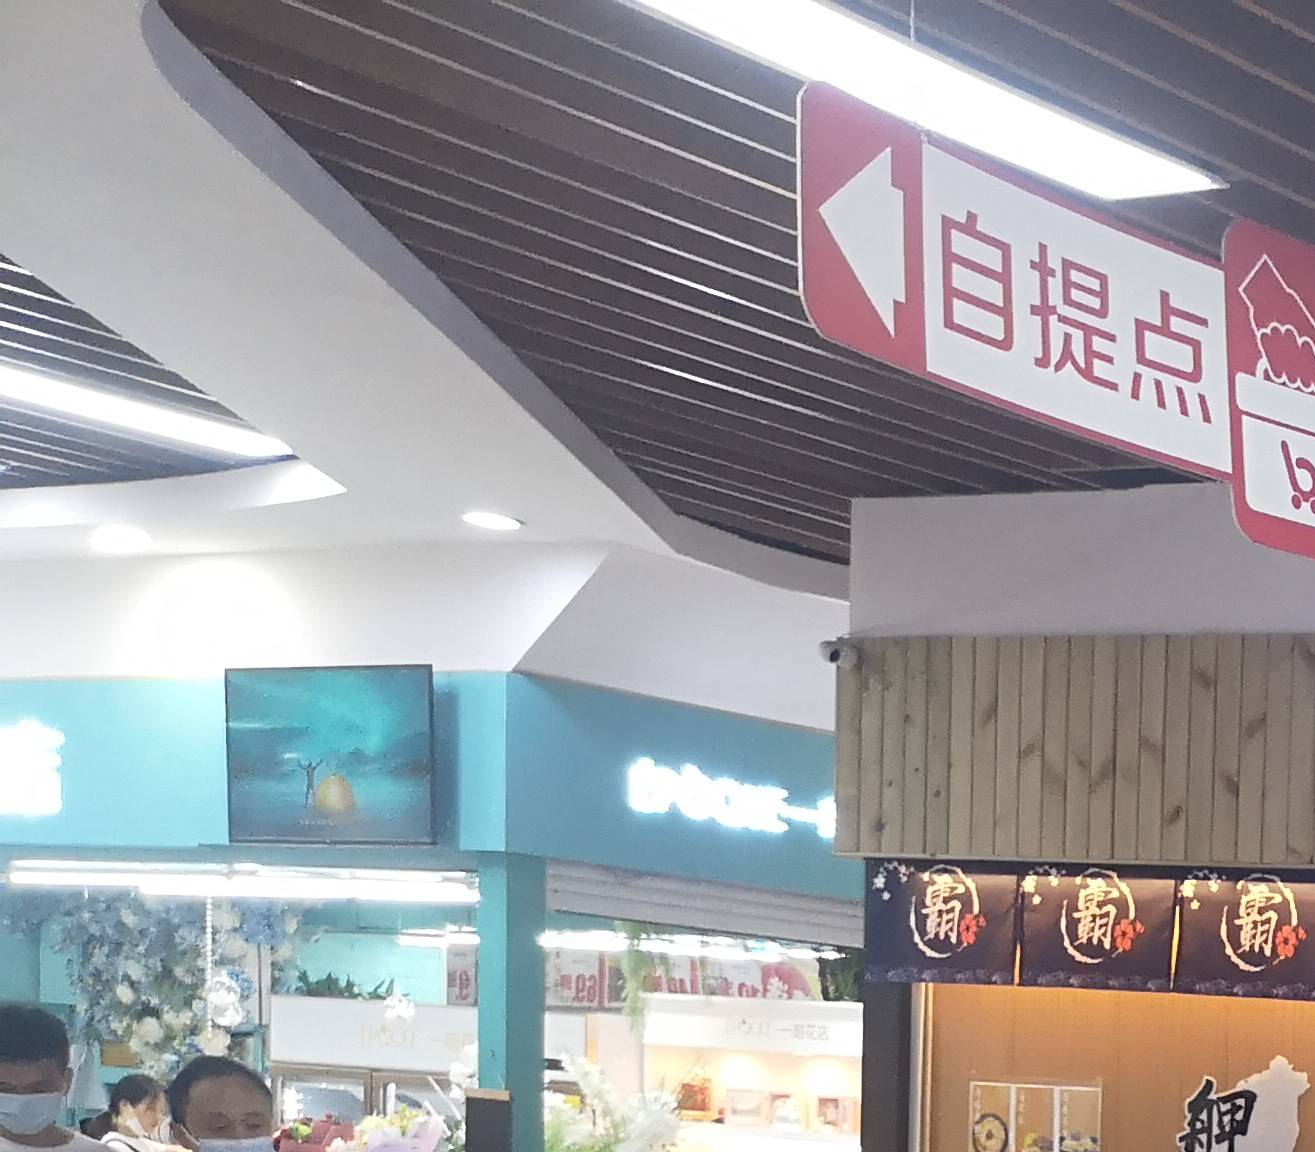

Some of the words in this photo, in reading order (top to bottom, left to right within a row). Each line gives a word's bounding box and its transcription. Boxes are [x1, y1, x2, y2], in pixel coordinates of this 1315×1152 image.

[941, 210, 1213, 425] 自提点
[921, 877, 963, 942] 霸
[1074, 881, 1119, 949] 霸
[1233, 883, 1282, 956] 霸
